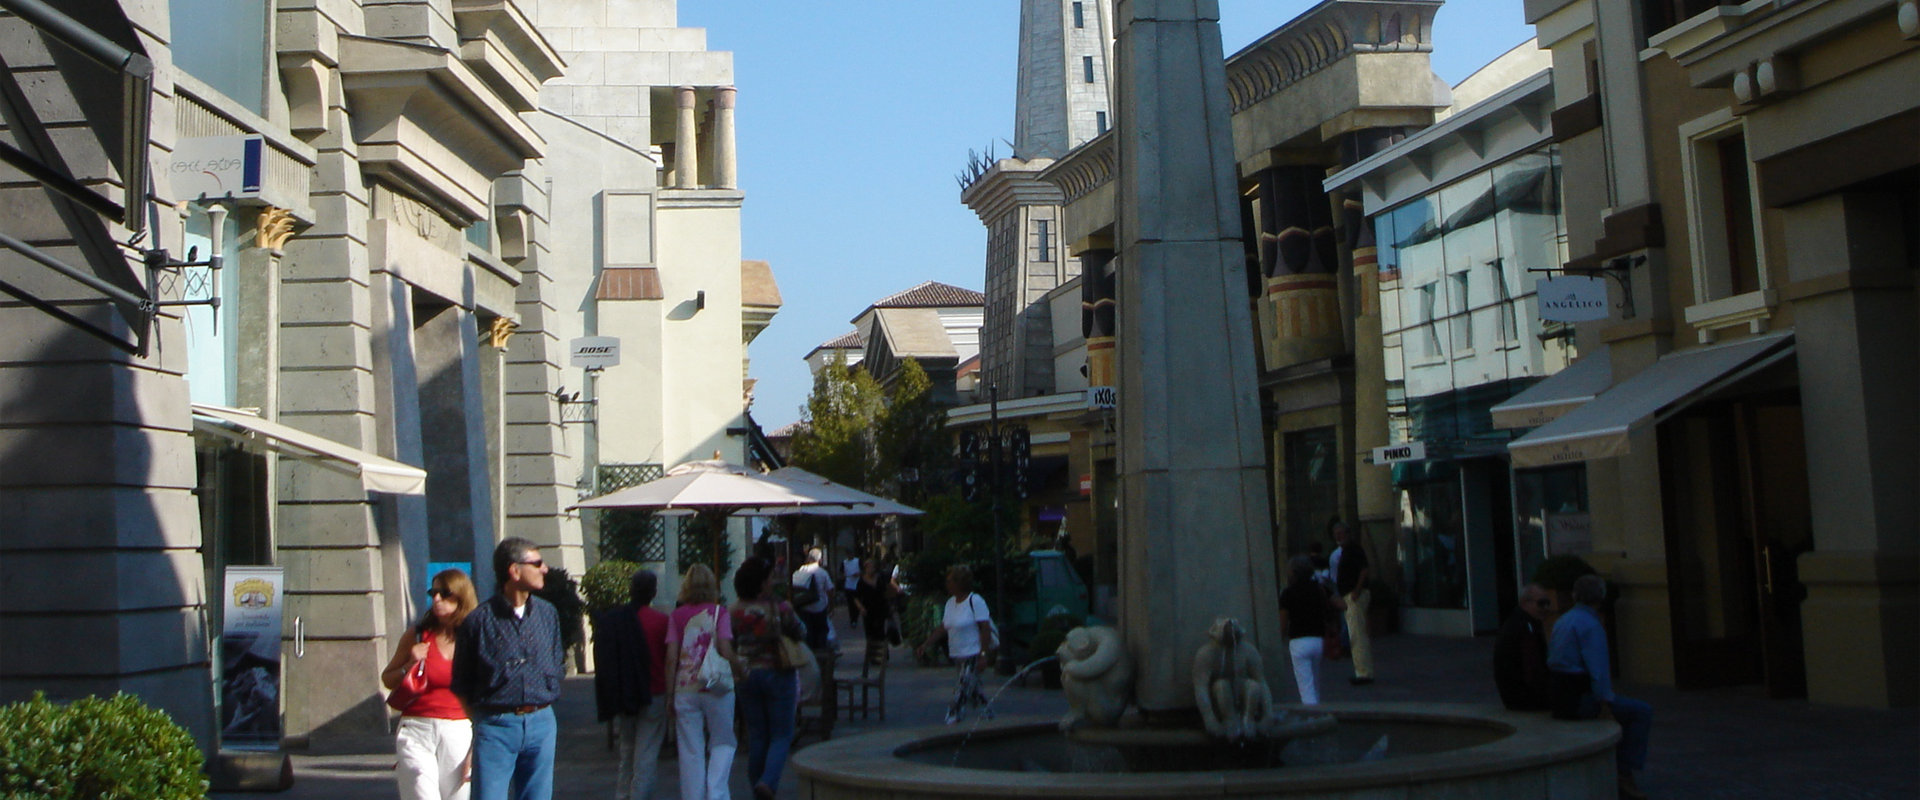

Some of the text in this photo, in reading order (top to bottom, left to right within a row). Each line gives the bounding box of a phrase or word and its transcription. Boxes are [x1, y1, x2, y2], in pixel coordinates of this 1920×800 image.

[1545, 301, 1603, 309] ANGELICO
[574, 346, 617, 354] BOSE
[1384, 447, 1411, 460] PINKO
